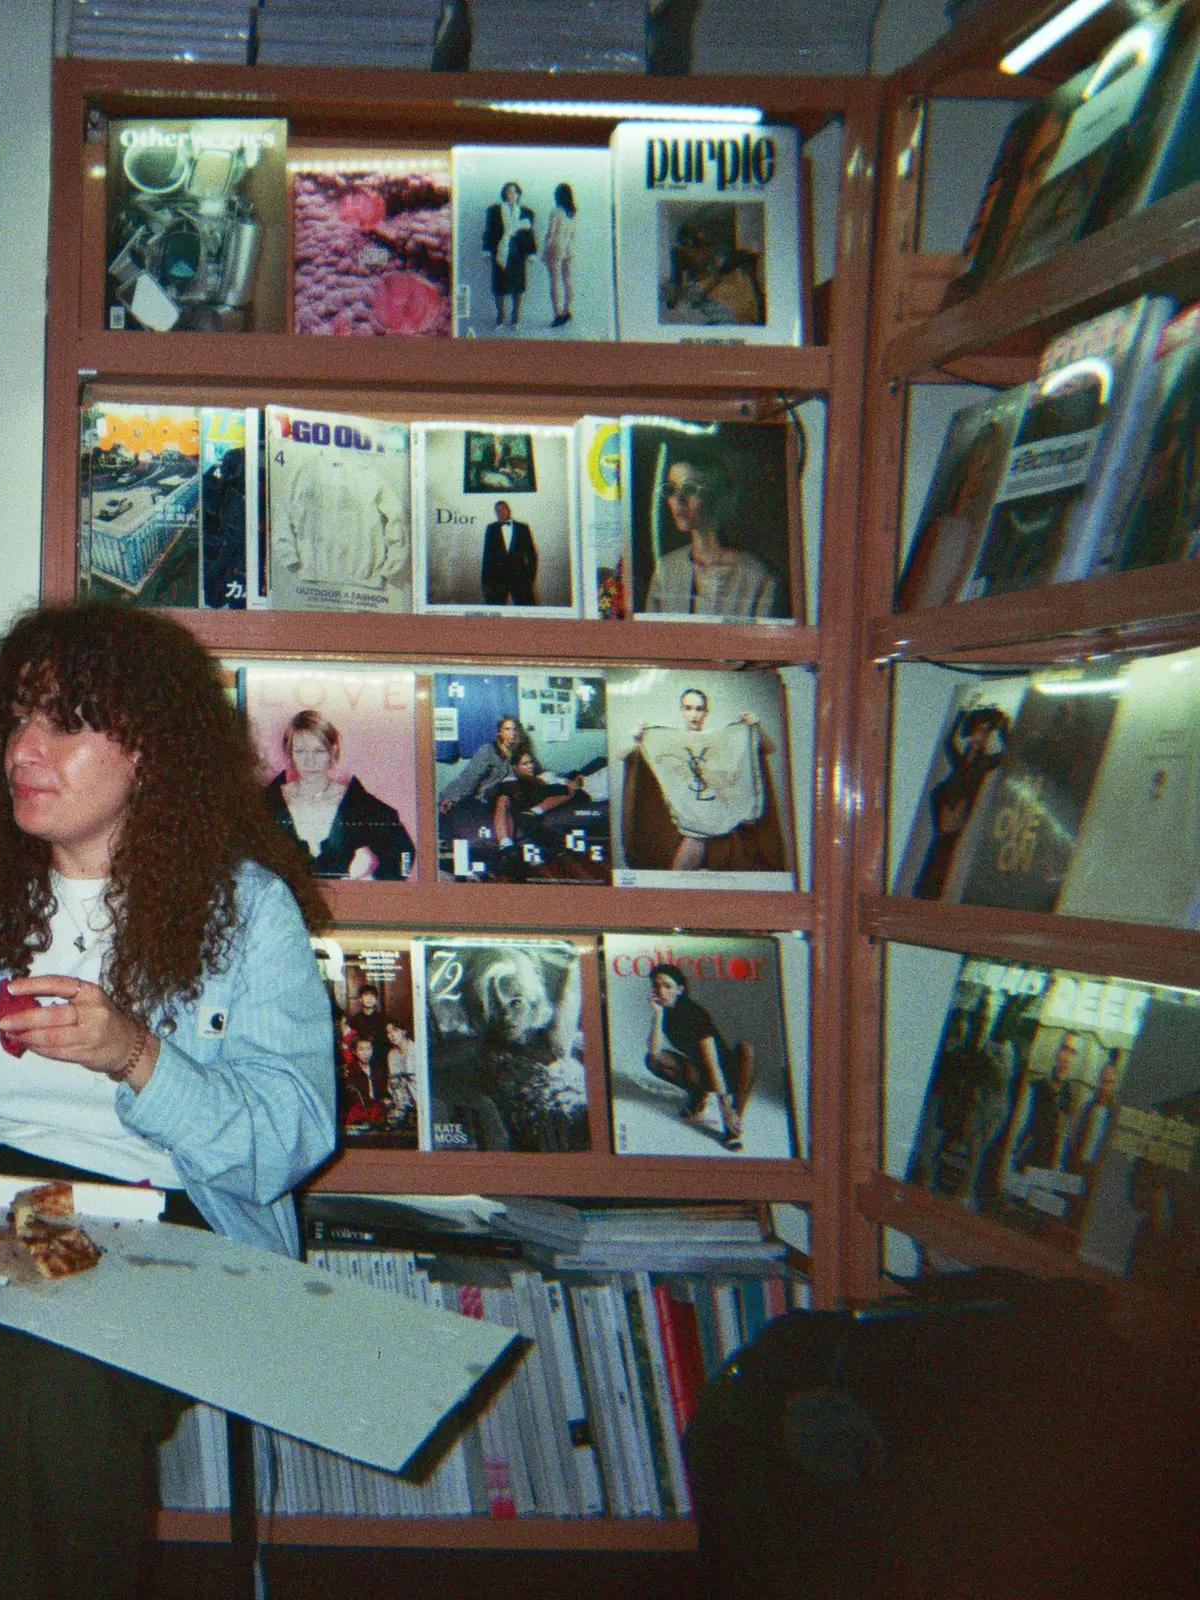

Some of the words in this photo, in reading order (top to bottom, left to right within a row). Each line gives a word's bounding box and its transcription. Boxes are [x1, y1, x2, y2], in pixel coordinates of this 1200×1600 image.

[646, 133, 777, 191] purple
[274, 450, 286, 467] 4
[435, 508, 477, 525] Dior
[225, 581, 247, 599] カ
[433, 1123, 464, 1133] KATE
